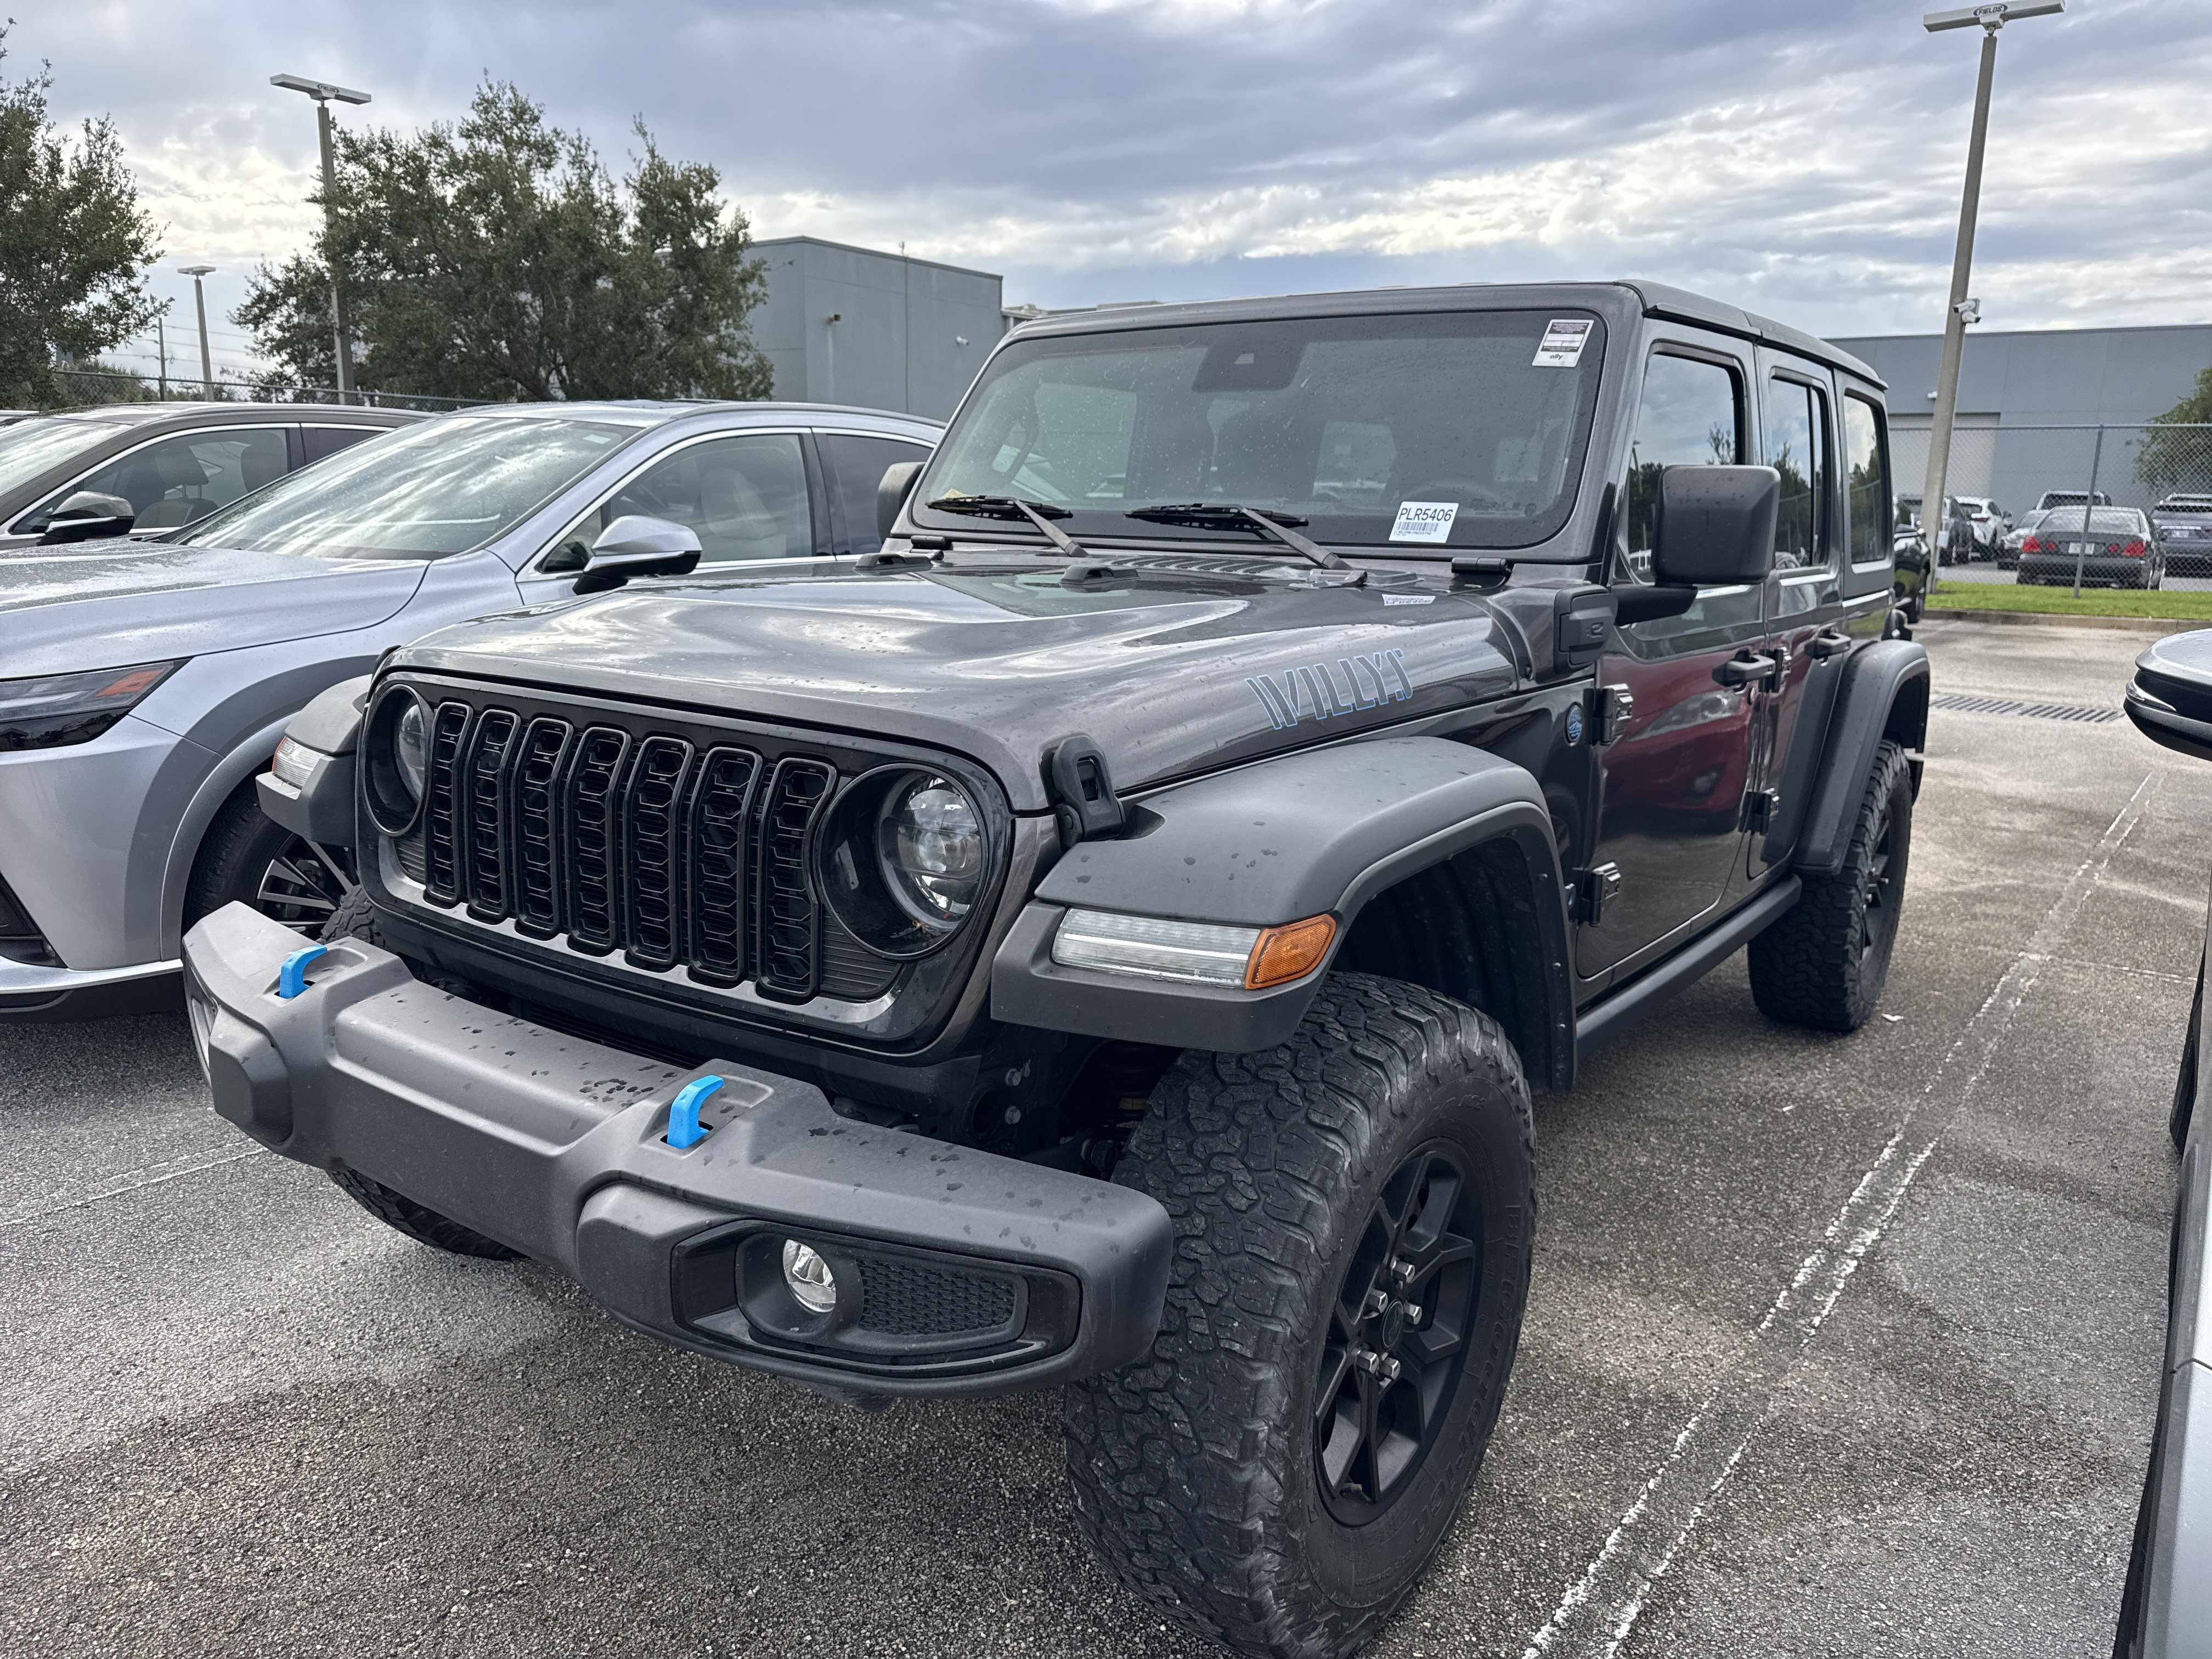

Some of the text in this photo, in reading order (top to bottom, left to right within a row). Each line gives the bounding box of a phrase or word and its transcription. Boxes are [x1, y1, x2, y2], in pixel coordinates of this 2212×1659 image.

[1978, 5, 2002, 15] FIELDS
[1398, 507, 1453, 522] PLR5406
[1244, 647, 1414, 730] WILLYS
